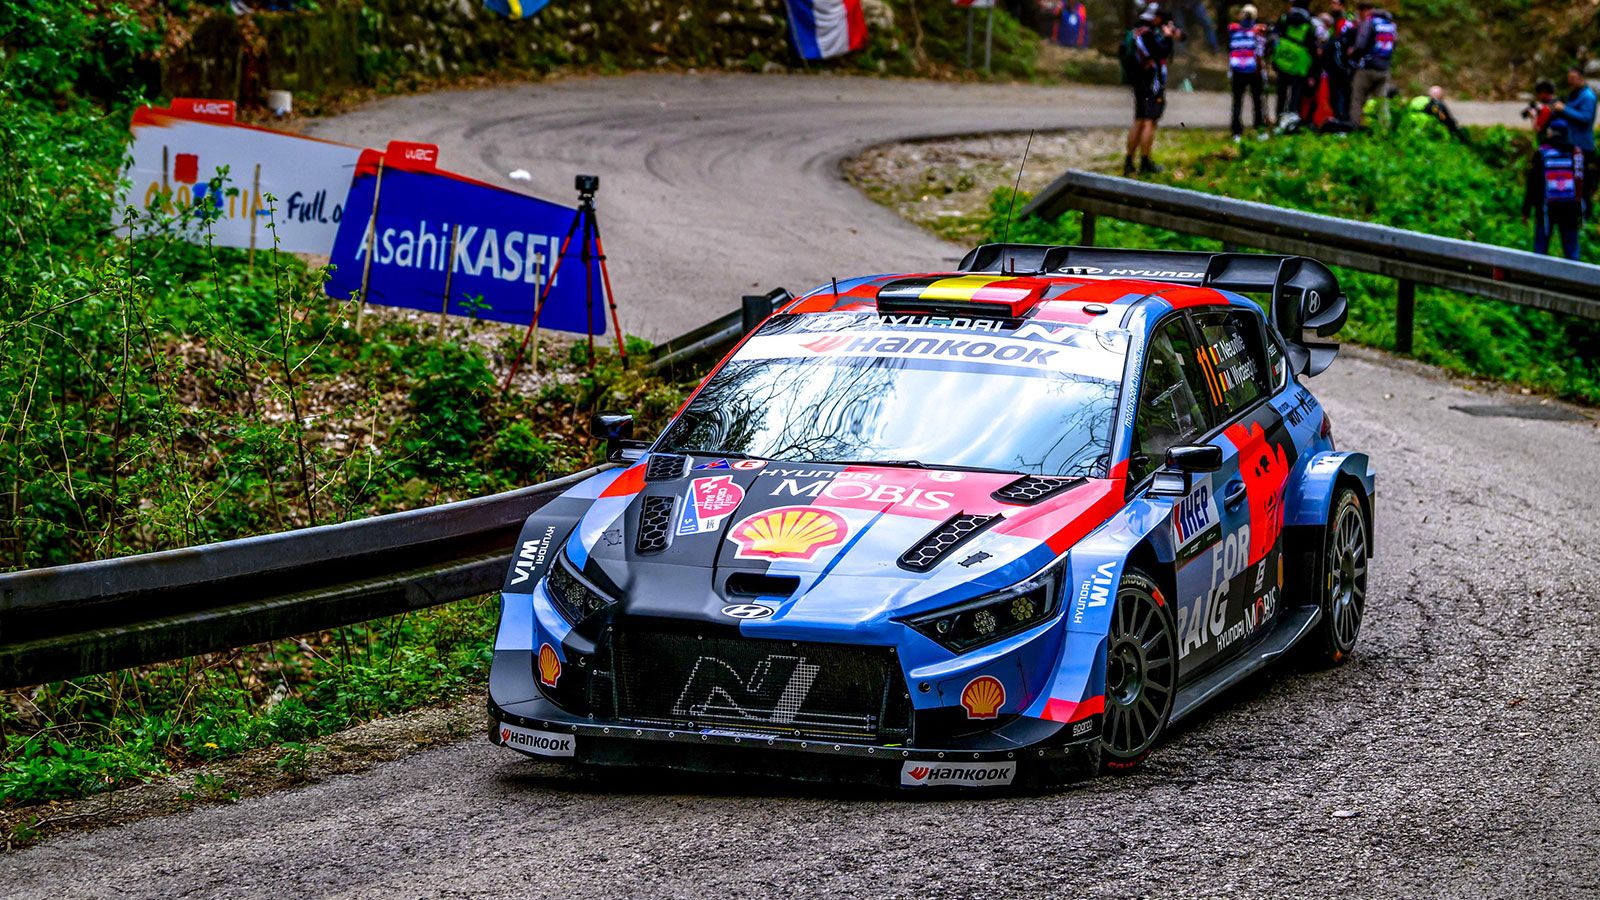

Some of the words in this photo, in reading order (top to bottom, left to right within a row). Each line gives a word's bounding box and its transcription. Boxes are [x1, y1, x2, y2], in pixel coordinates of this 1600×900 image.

[193, 102, 230, 115] WRC
[405, 149, 433, 161] WRC
[1109, 268, 1206, 279] HYUNDA
[842, 335, 1060, 366] HANKOOK
[757, 468, 884, 482] HYUNDAI
[769, 478, 956, 511] MOBIS
[535, 526, 556, 565] HYUNDAI
[1211, 523, 1250, 590] FOR
[1073, 580, 1092, 625] HYUNDAI
[1178, 579, 1230, 661] RAIG
[510, 731, 571, 752] HANKOOK
[926, 766, 1012, 782] HANKOOK
